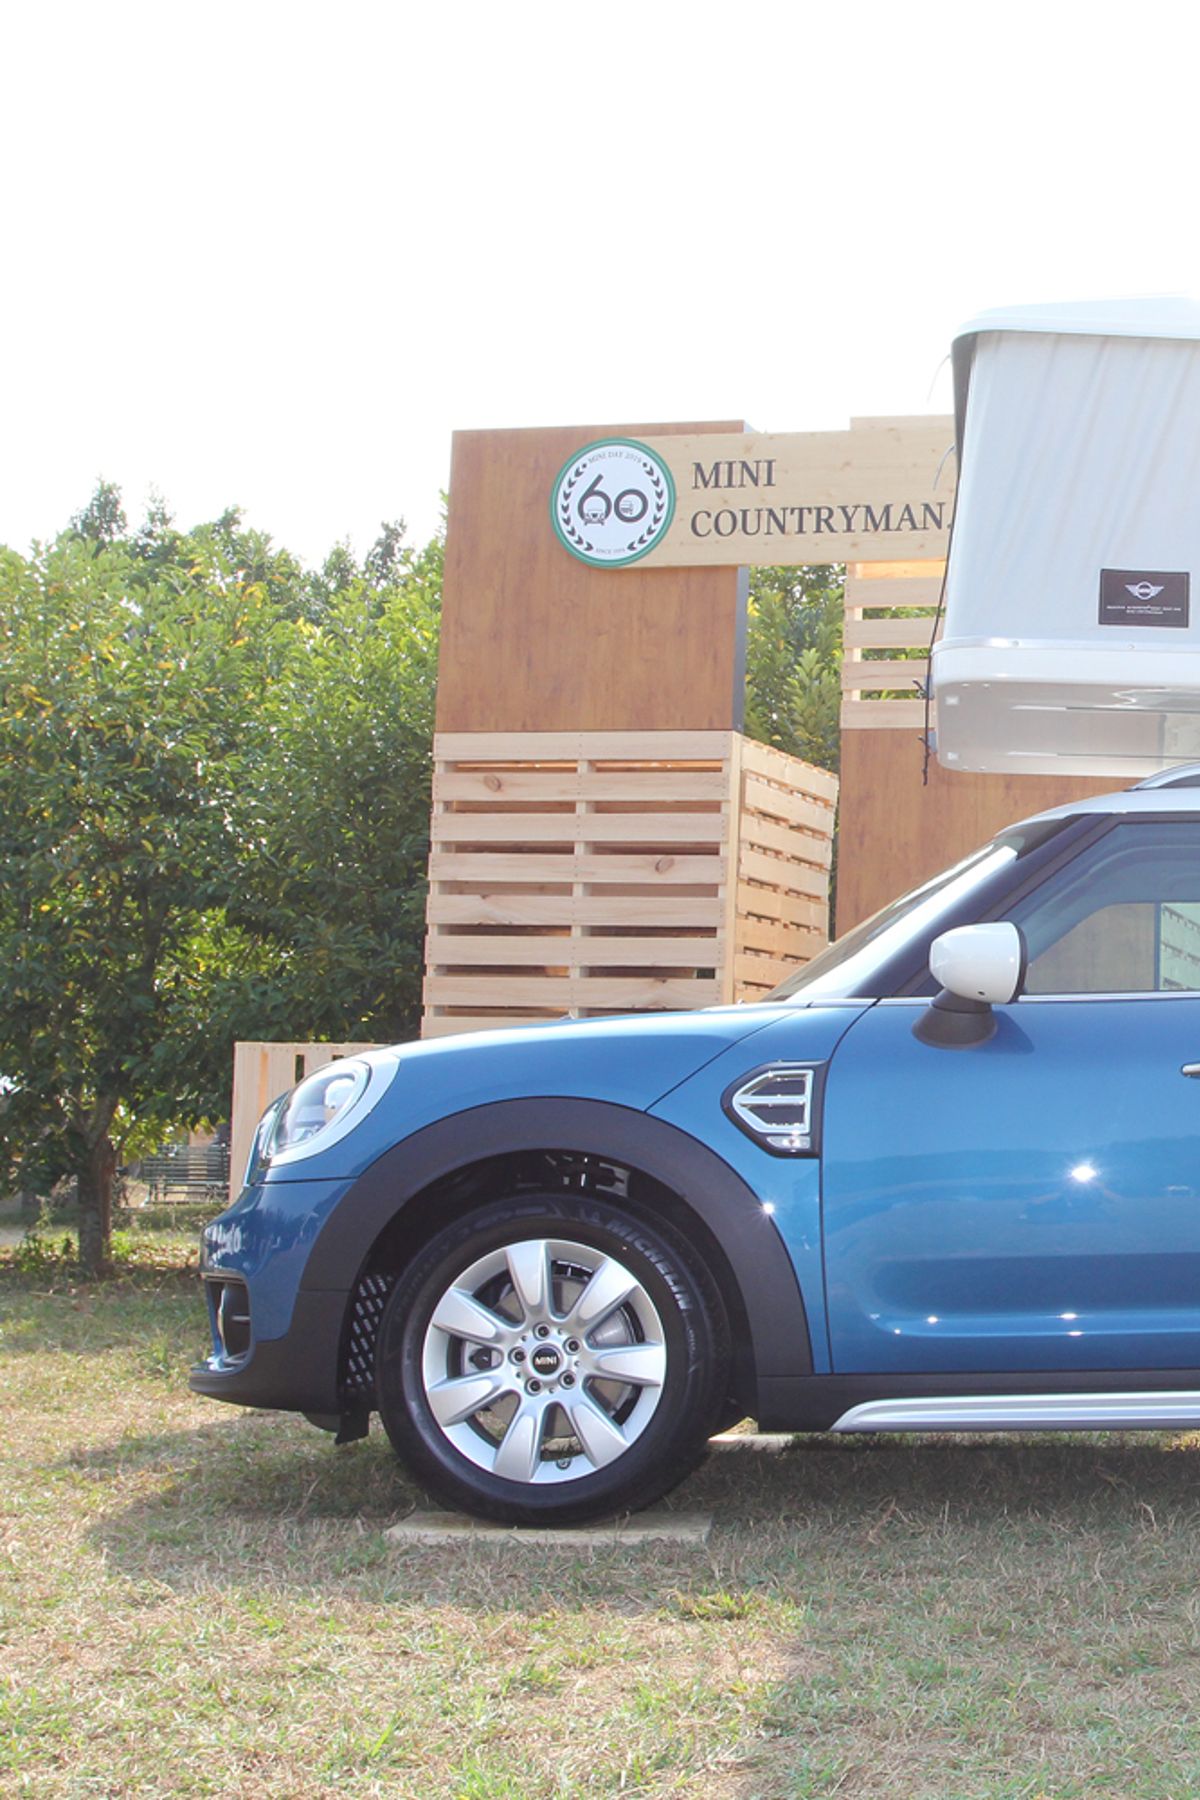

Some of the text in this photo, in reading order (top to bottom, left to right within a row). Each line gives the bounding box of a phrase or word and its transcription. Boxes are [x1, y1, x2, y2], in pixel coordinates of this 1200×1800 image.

[691, 459, 776, 490] MINI
[578, 473, 649, 526] 60
[606, 1219, 692, 1310] MICHELIN
[534, 1355, 558, 1366] MINI
